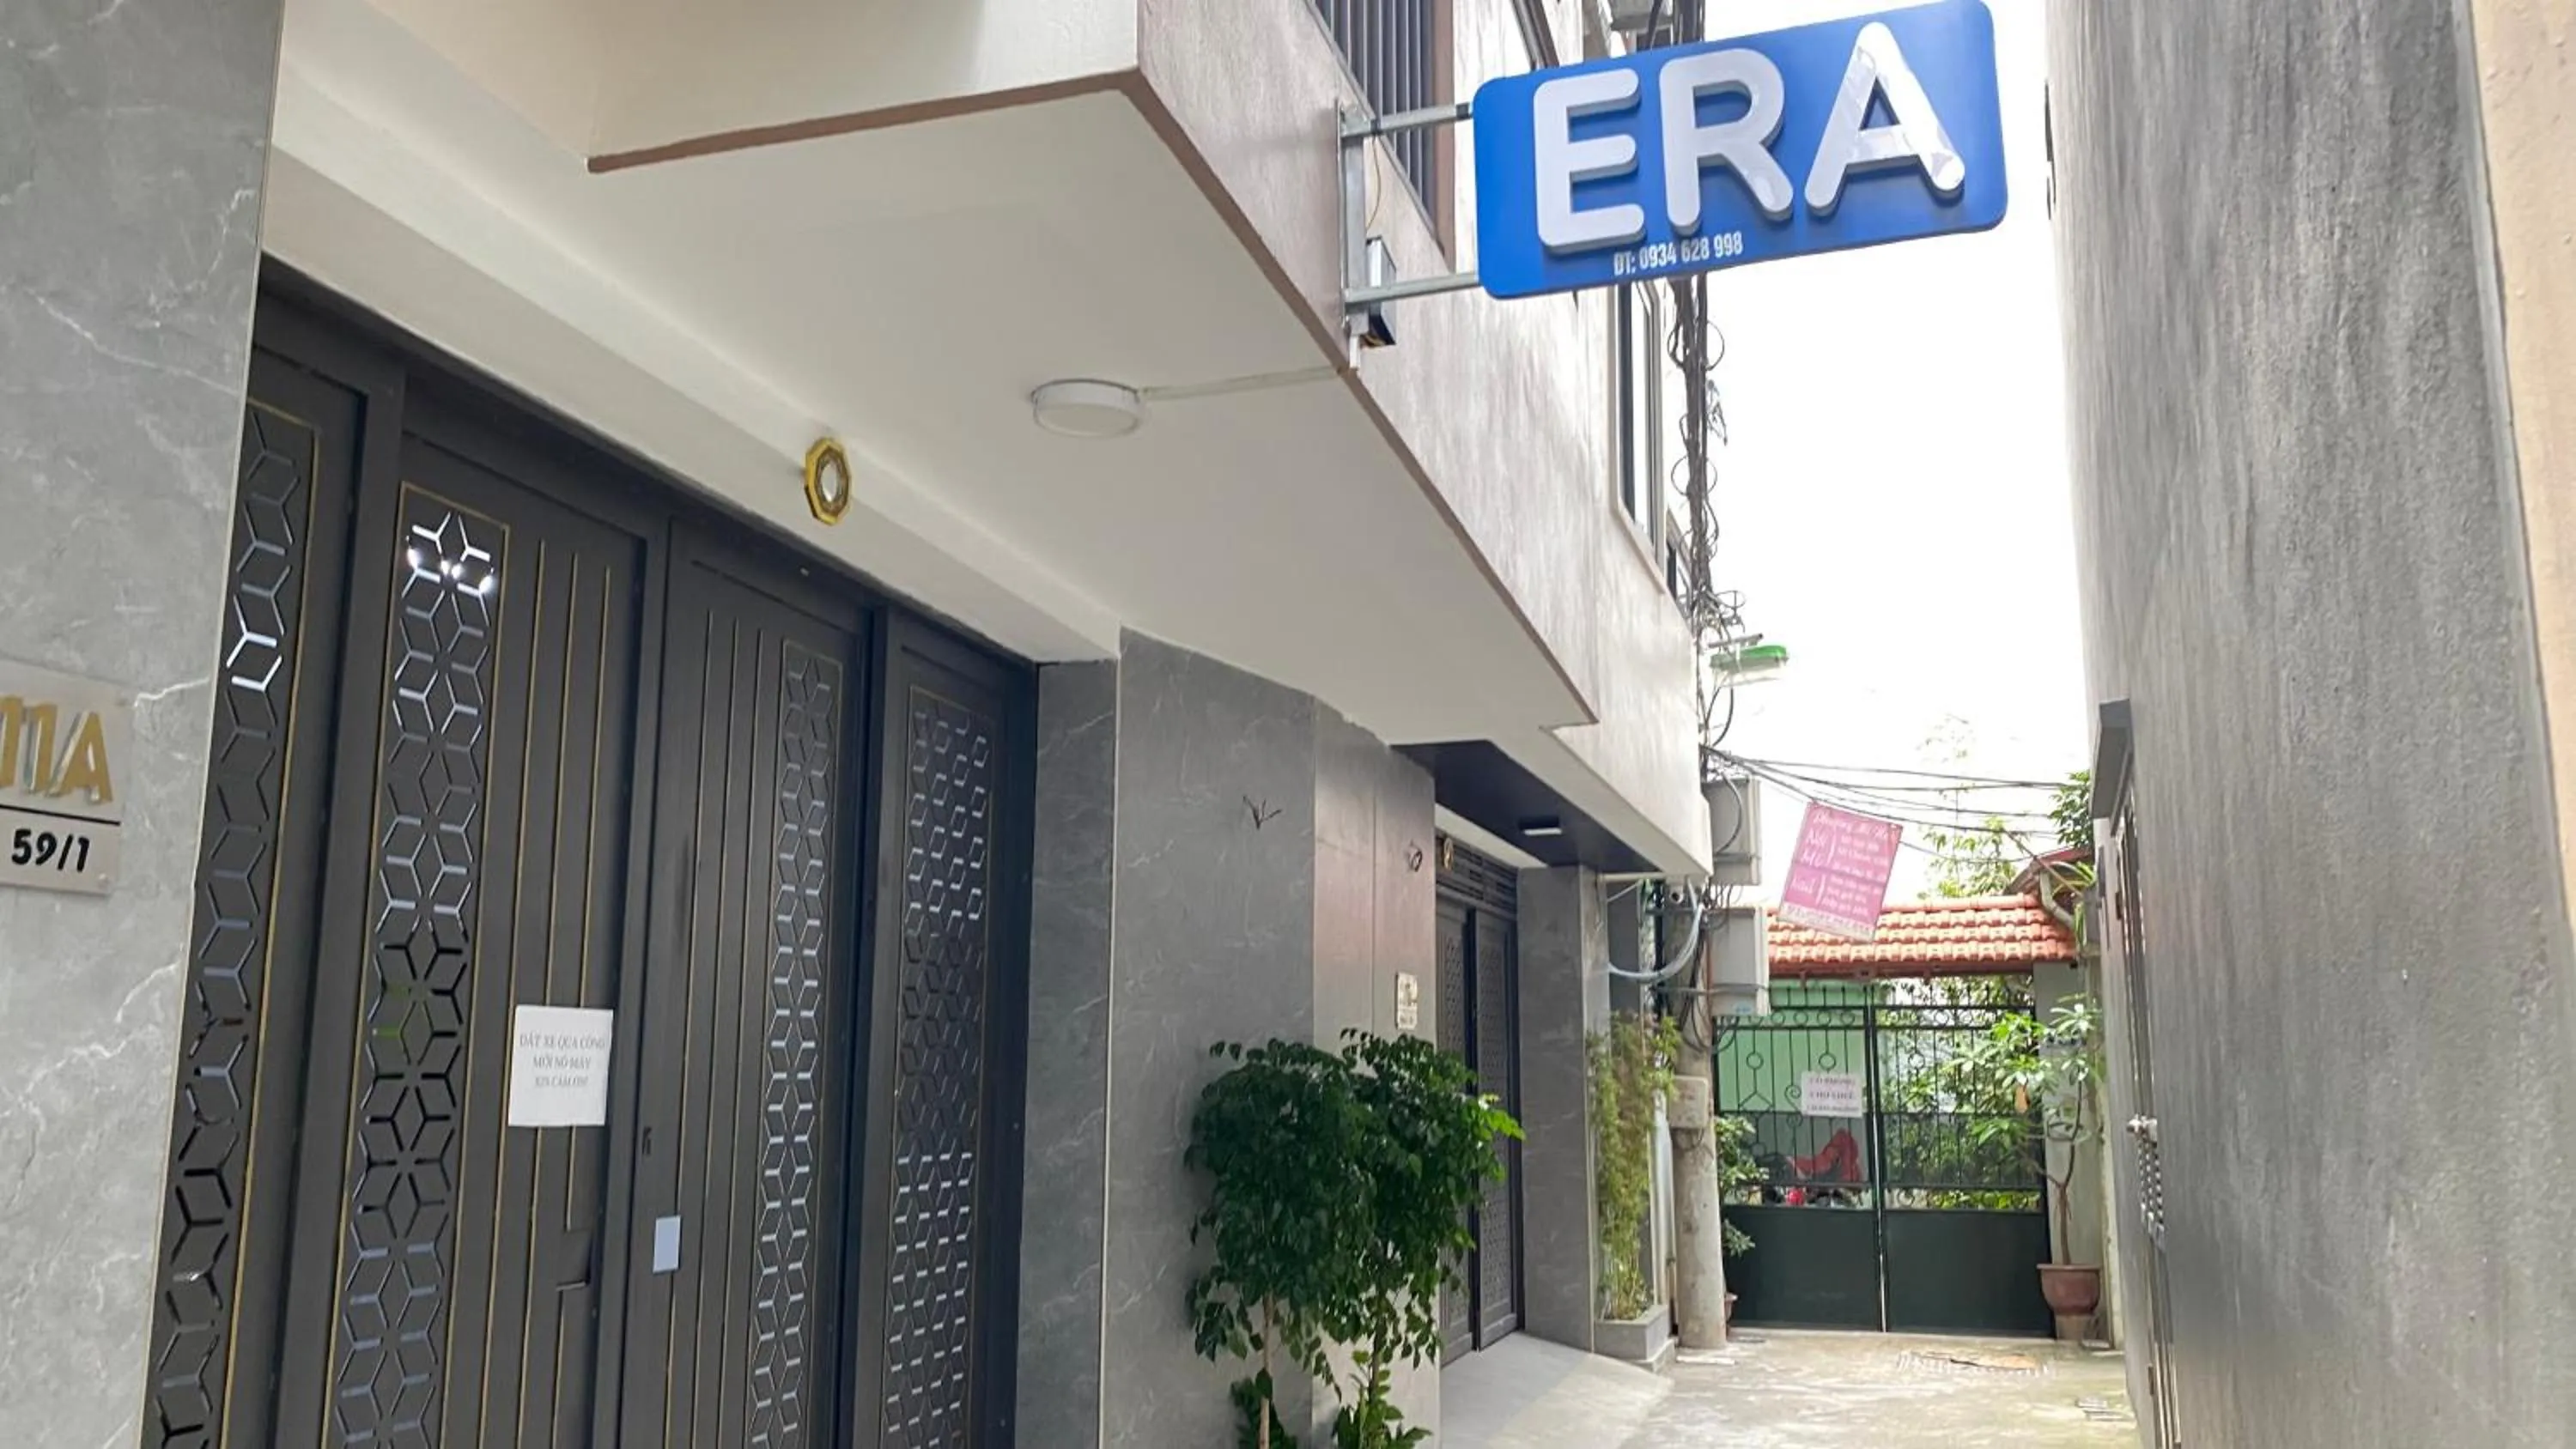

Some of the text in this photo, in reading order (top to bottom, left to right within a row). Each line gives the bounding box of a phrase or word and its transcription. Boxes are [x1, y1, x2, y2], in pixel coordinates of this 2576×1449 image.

[1534, 21, 1965, 251] ERA
[1639, 242, 1677, 270] 0934
[1680, 237, 1710, 263] 628
[1714, 230, 1743, 258] 998
[11, 828, 90, 872] 59/1
